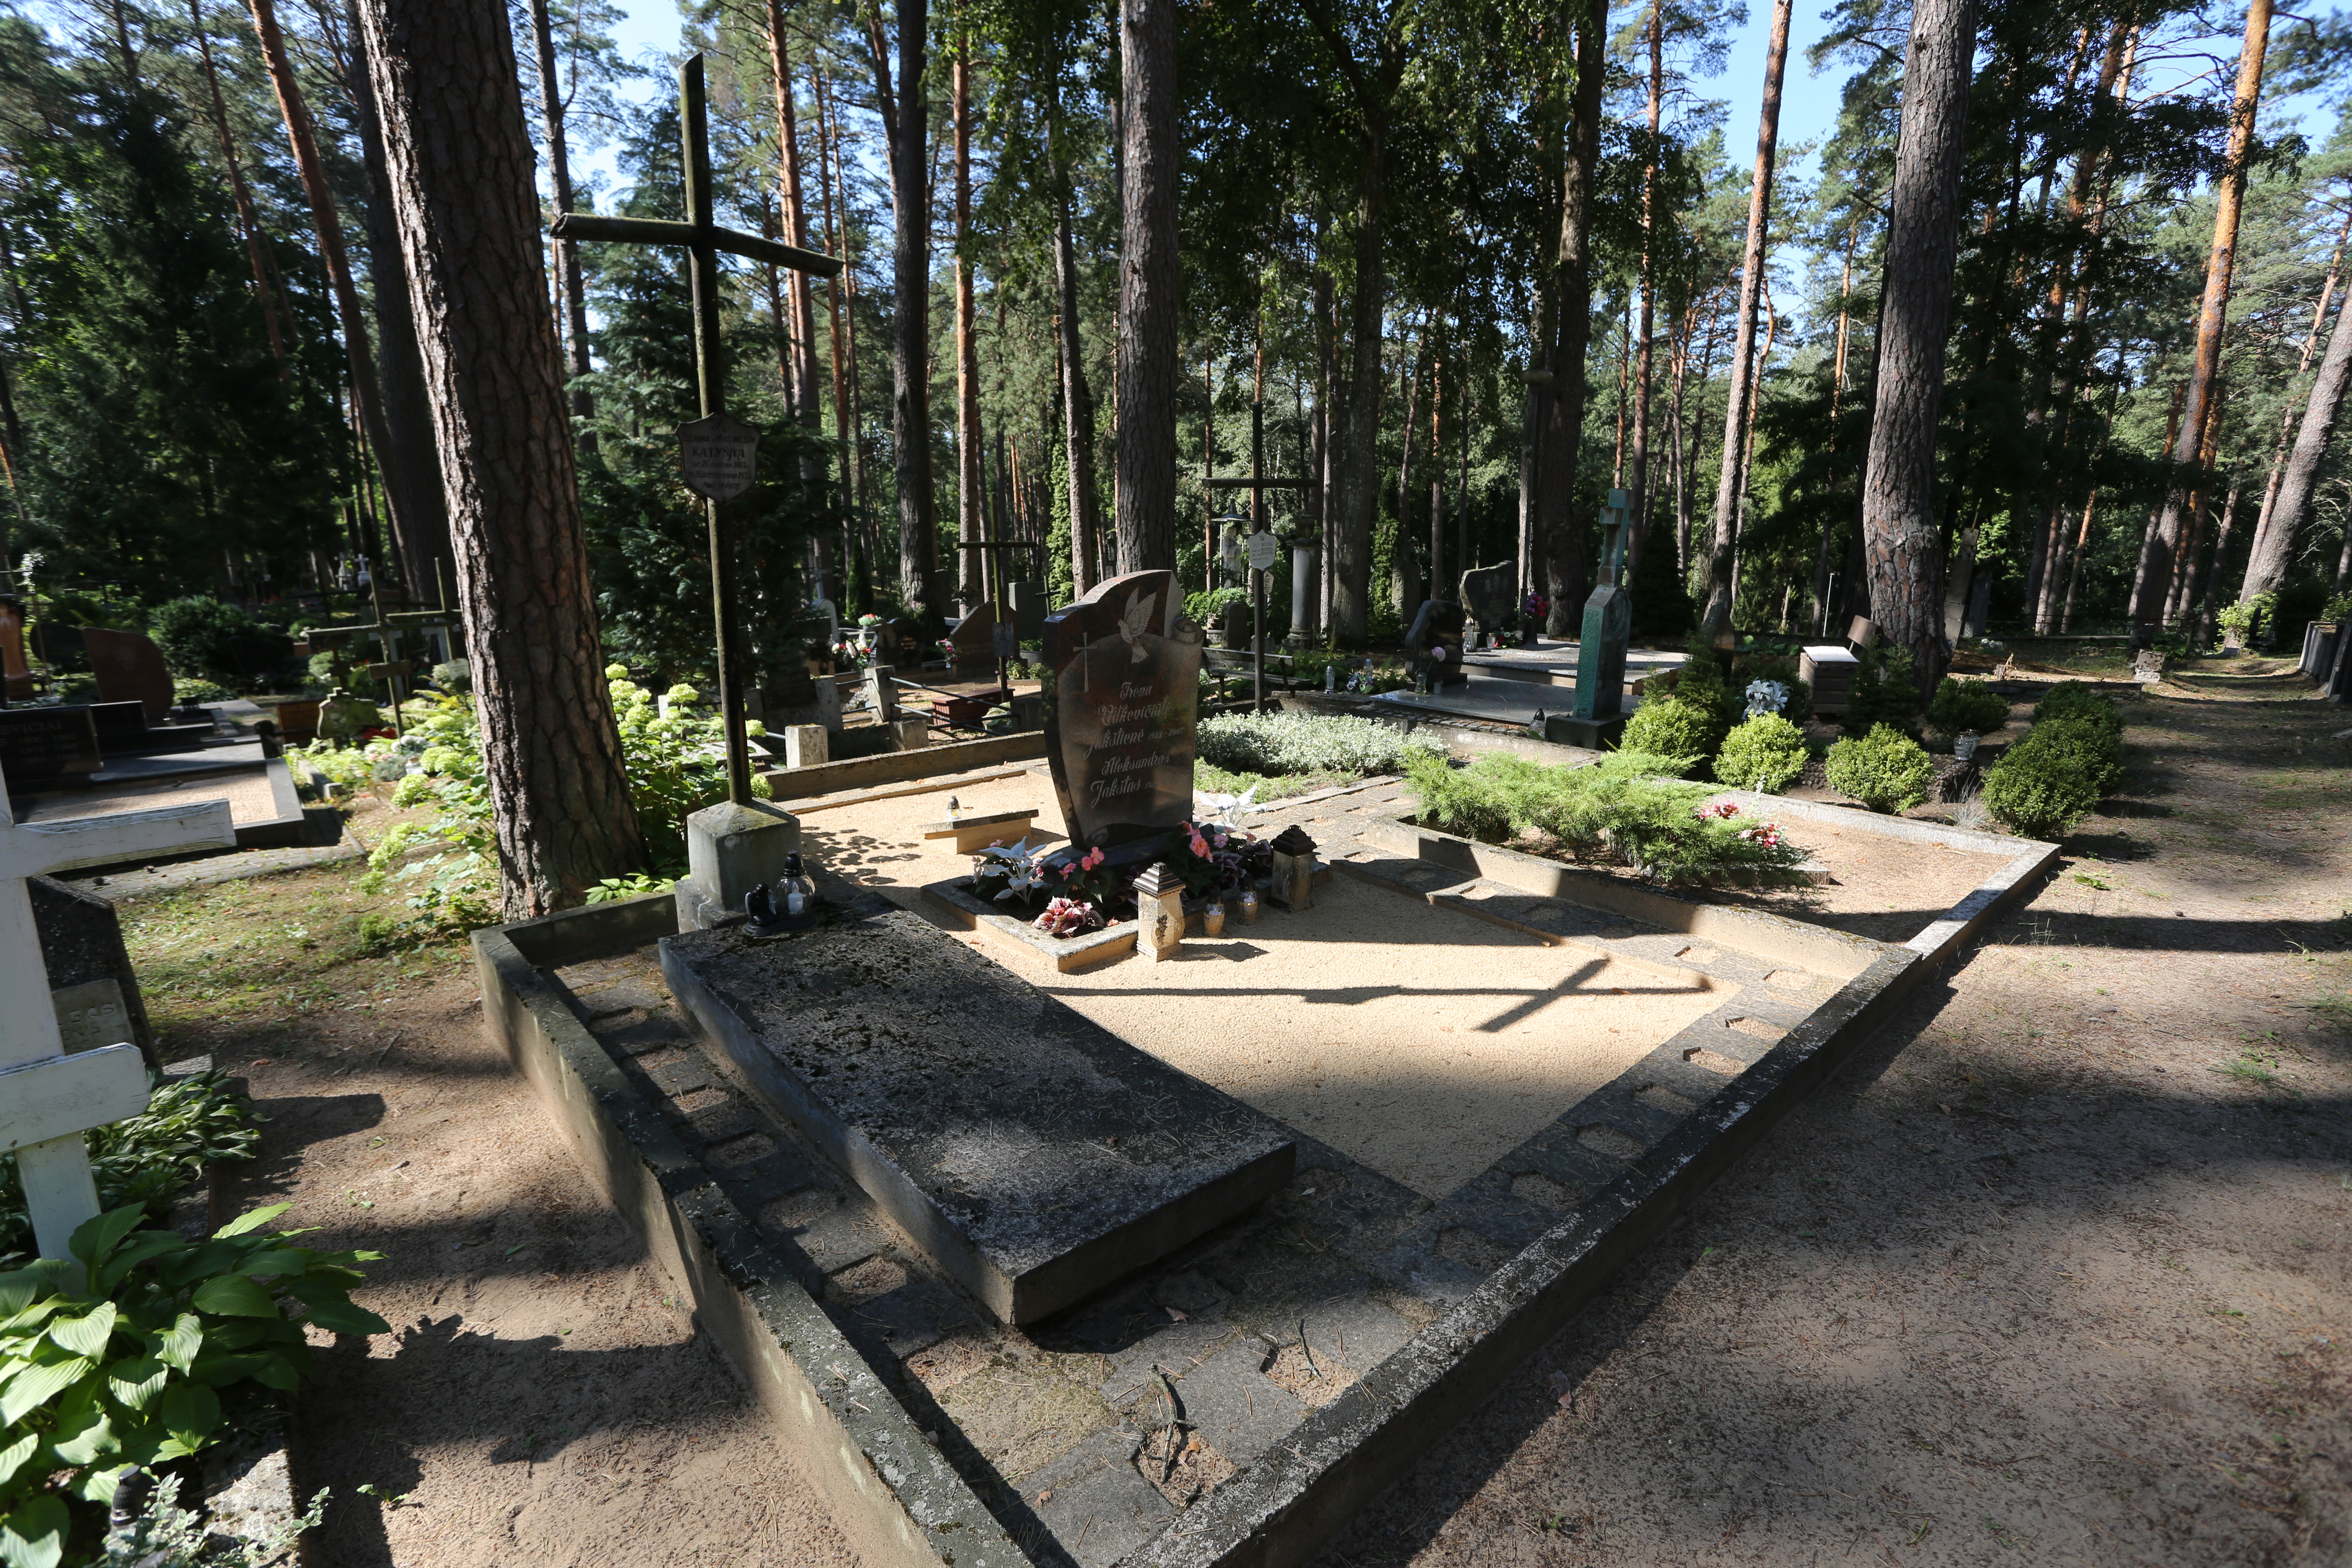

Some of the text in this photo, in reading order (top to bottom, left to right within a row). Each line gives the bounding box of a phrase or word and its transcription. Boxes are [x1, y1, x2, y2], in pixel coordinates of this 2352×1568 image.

[1120, 682, 1152, 699] Irena
[1101, 751, 1170, 776] Aleksandras
[1090, 775, 1141, 809] Jakštas
